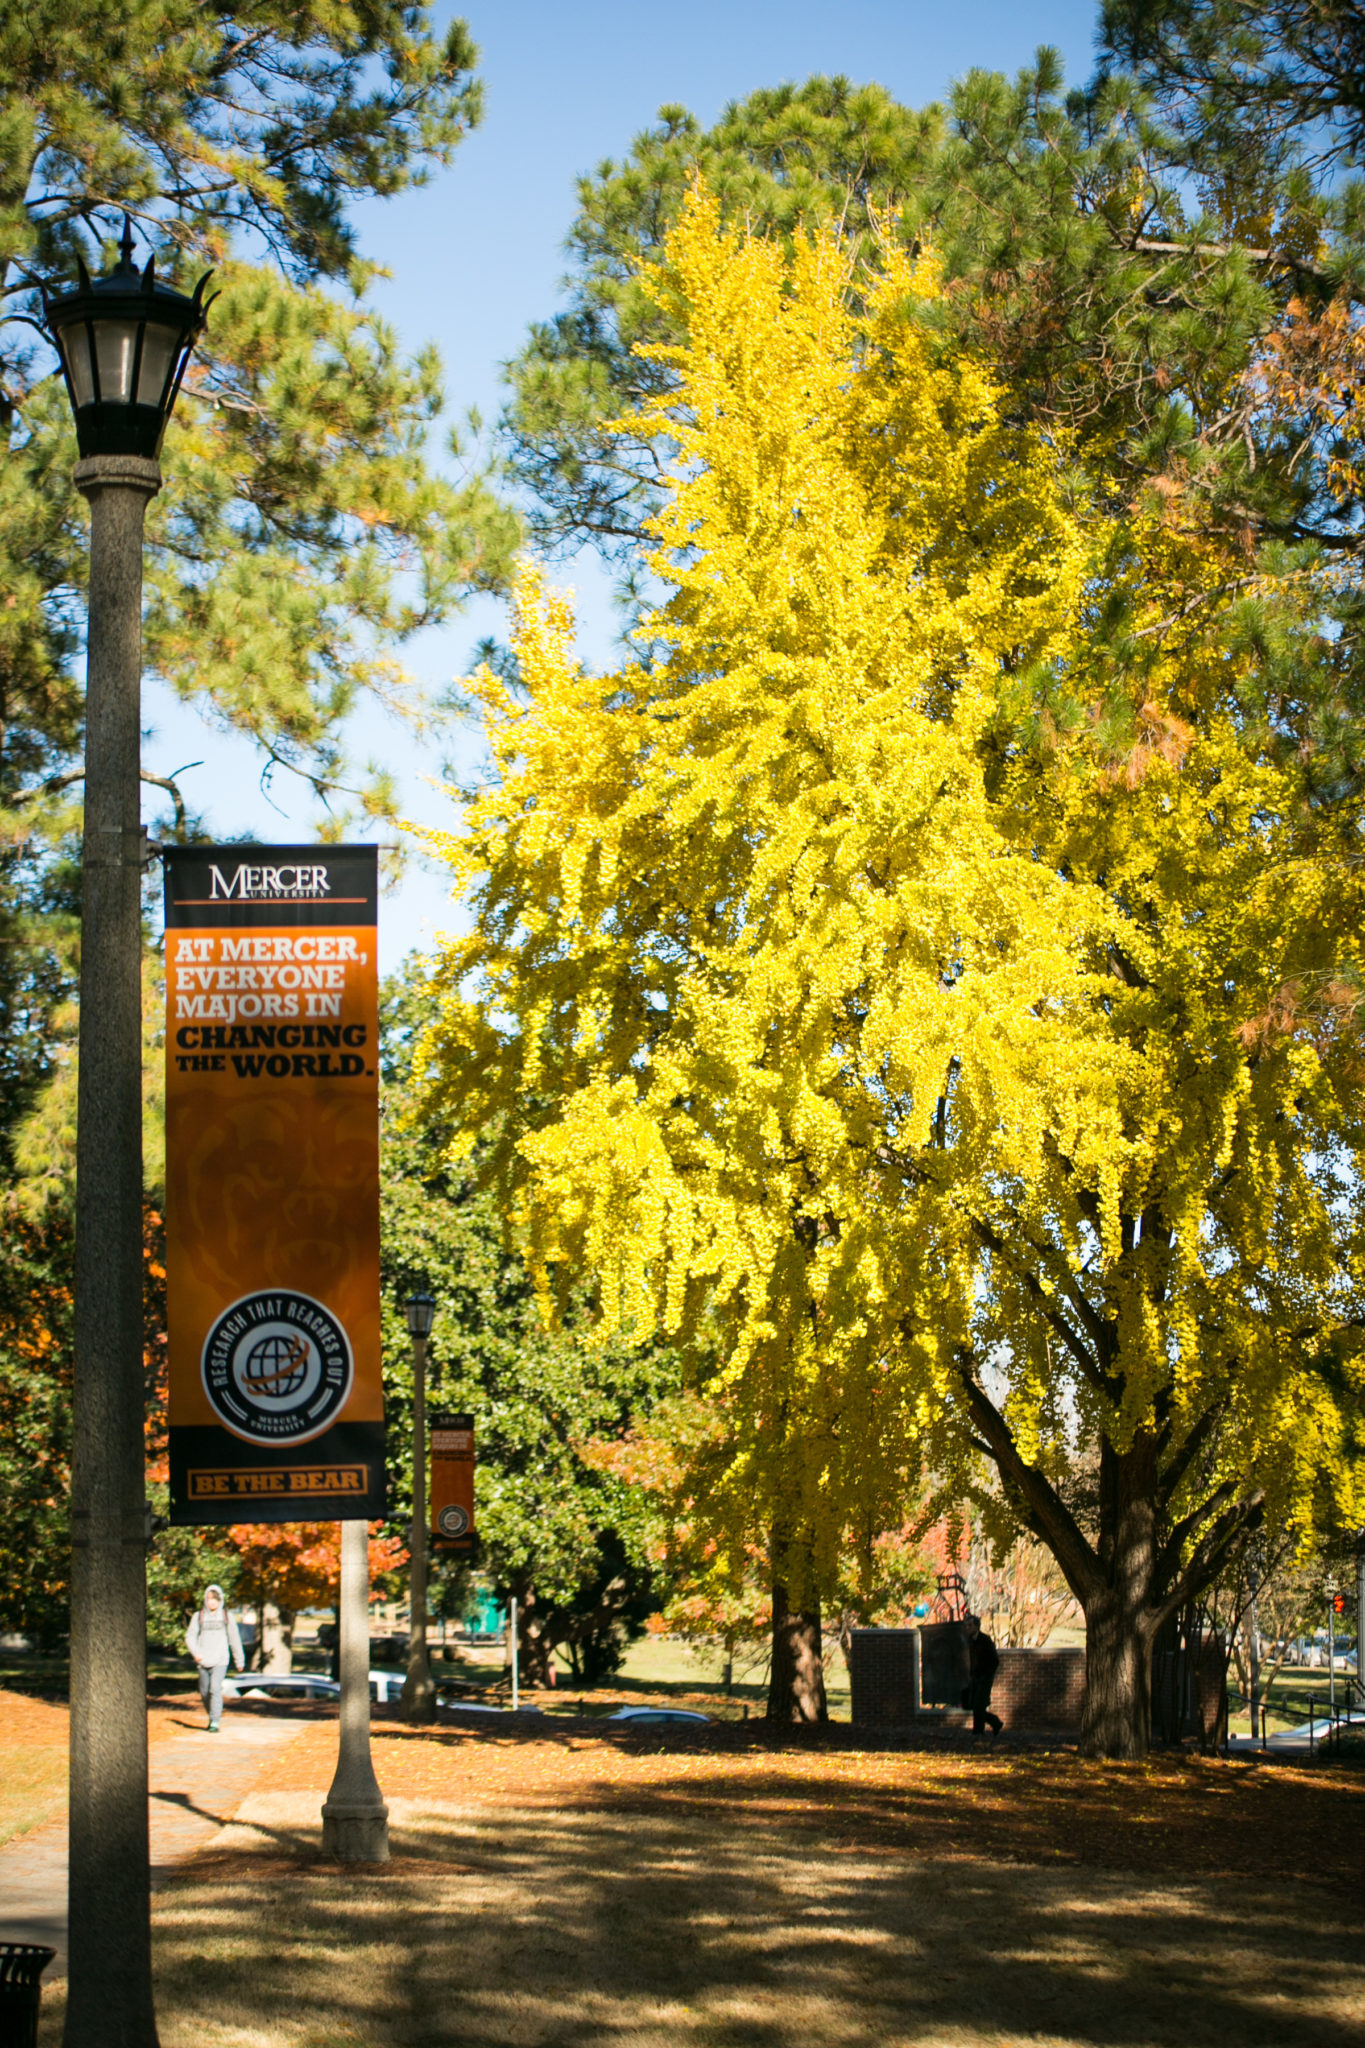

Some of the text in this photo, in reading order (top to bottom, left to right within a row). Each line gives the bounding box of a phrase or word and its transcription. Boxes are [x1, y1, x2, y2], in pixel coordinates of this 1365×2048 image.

[208, 864, 331, 899] MERCER
[250, 889, 326, 898] UNIVERSITY
[174, 936, 367, 965] AT MERCER,
[175, 965, 345, 990] EVERYONE
[175, 993, 342, 1024] MAJORS IN
[175, 1024, 367, 1049] CHANGING
[175, 1054, 374, 1078] THE WORLD.
[211, 1299, 344, 1387] RESEARCH THAT REACHES OUT
[250, 1419, 305, 1433] UNIVERSITY
[258, 1414, 298, 1425] MERCER
[195, 1471, 360, 1493] BE THE BEAR
